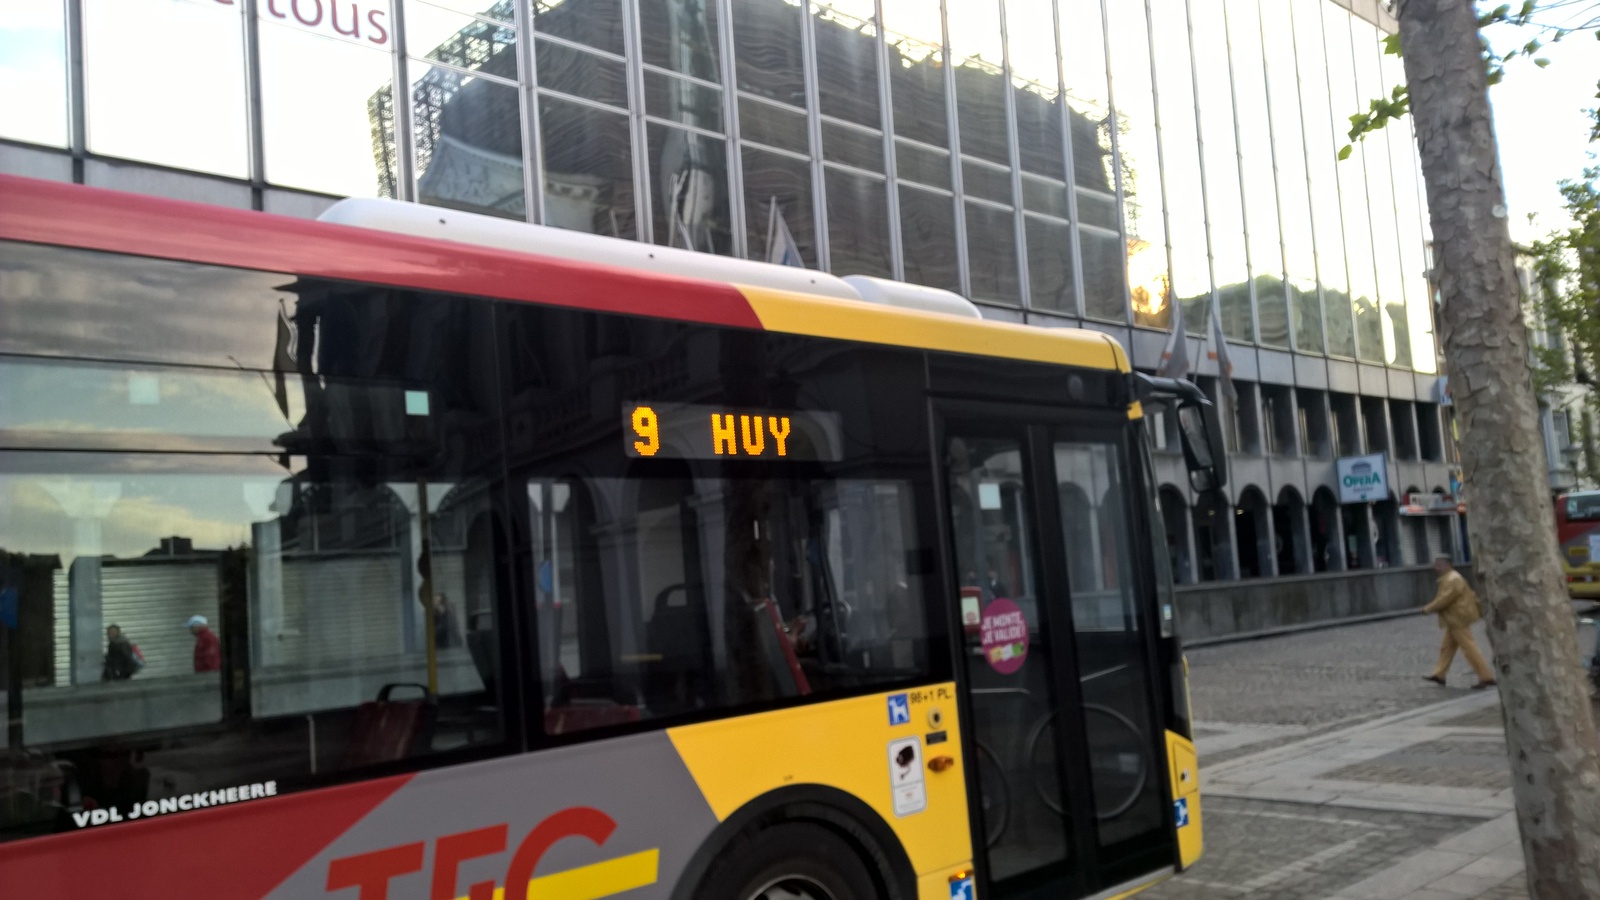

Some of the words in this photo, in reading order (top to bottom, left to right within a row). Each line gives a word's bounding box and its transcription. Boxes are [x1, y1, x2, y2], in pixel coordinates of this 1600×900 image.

[632, 406, 660, 456] 9
[711, 413, 791, 456] HUY
[1343, 471, 1381, 488] OPERA
[72, 806, 123, 828] VDL
[128, 780, 277, 820] JONCKHEERE
